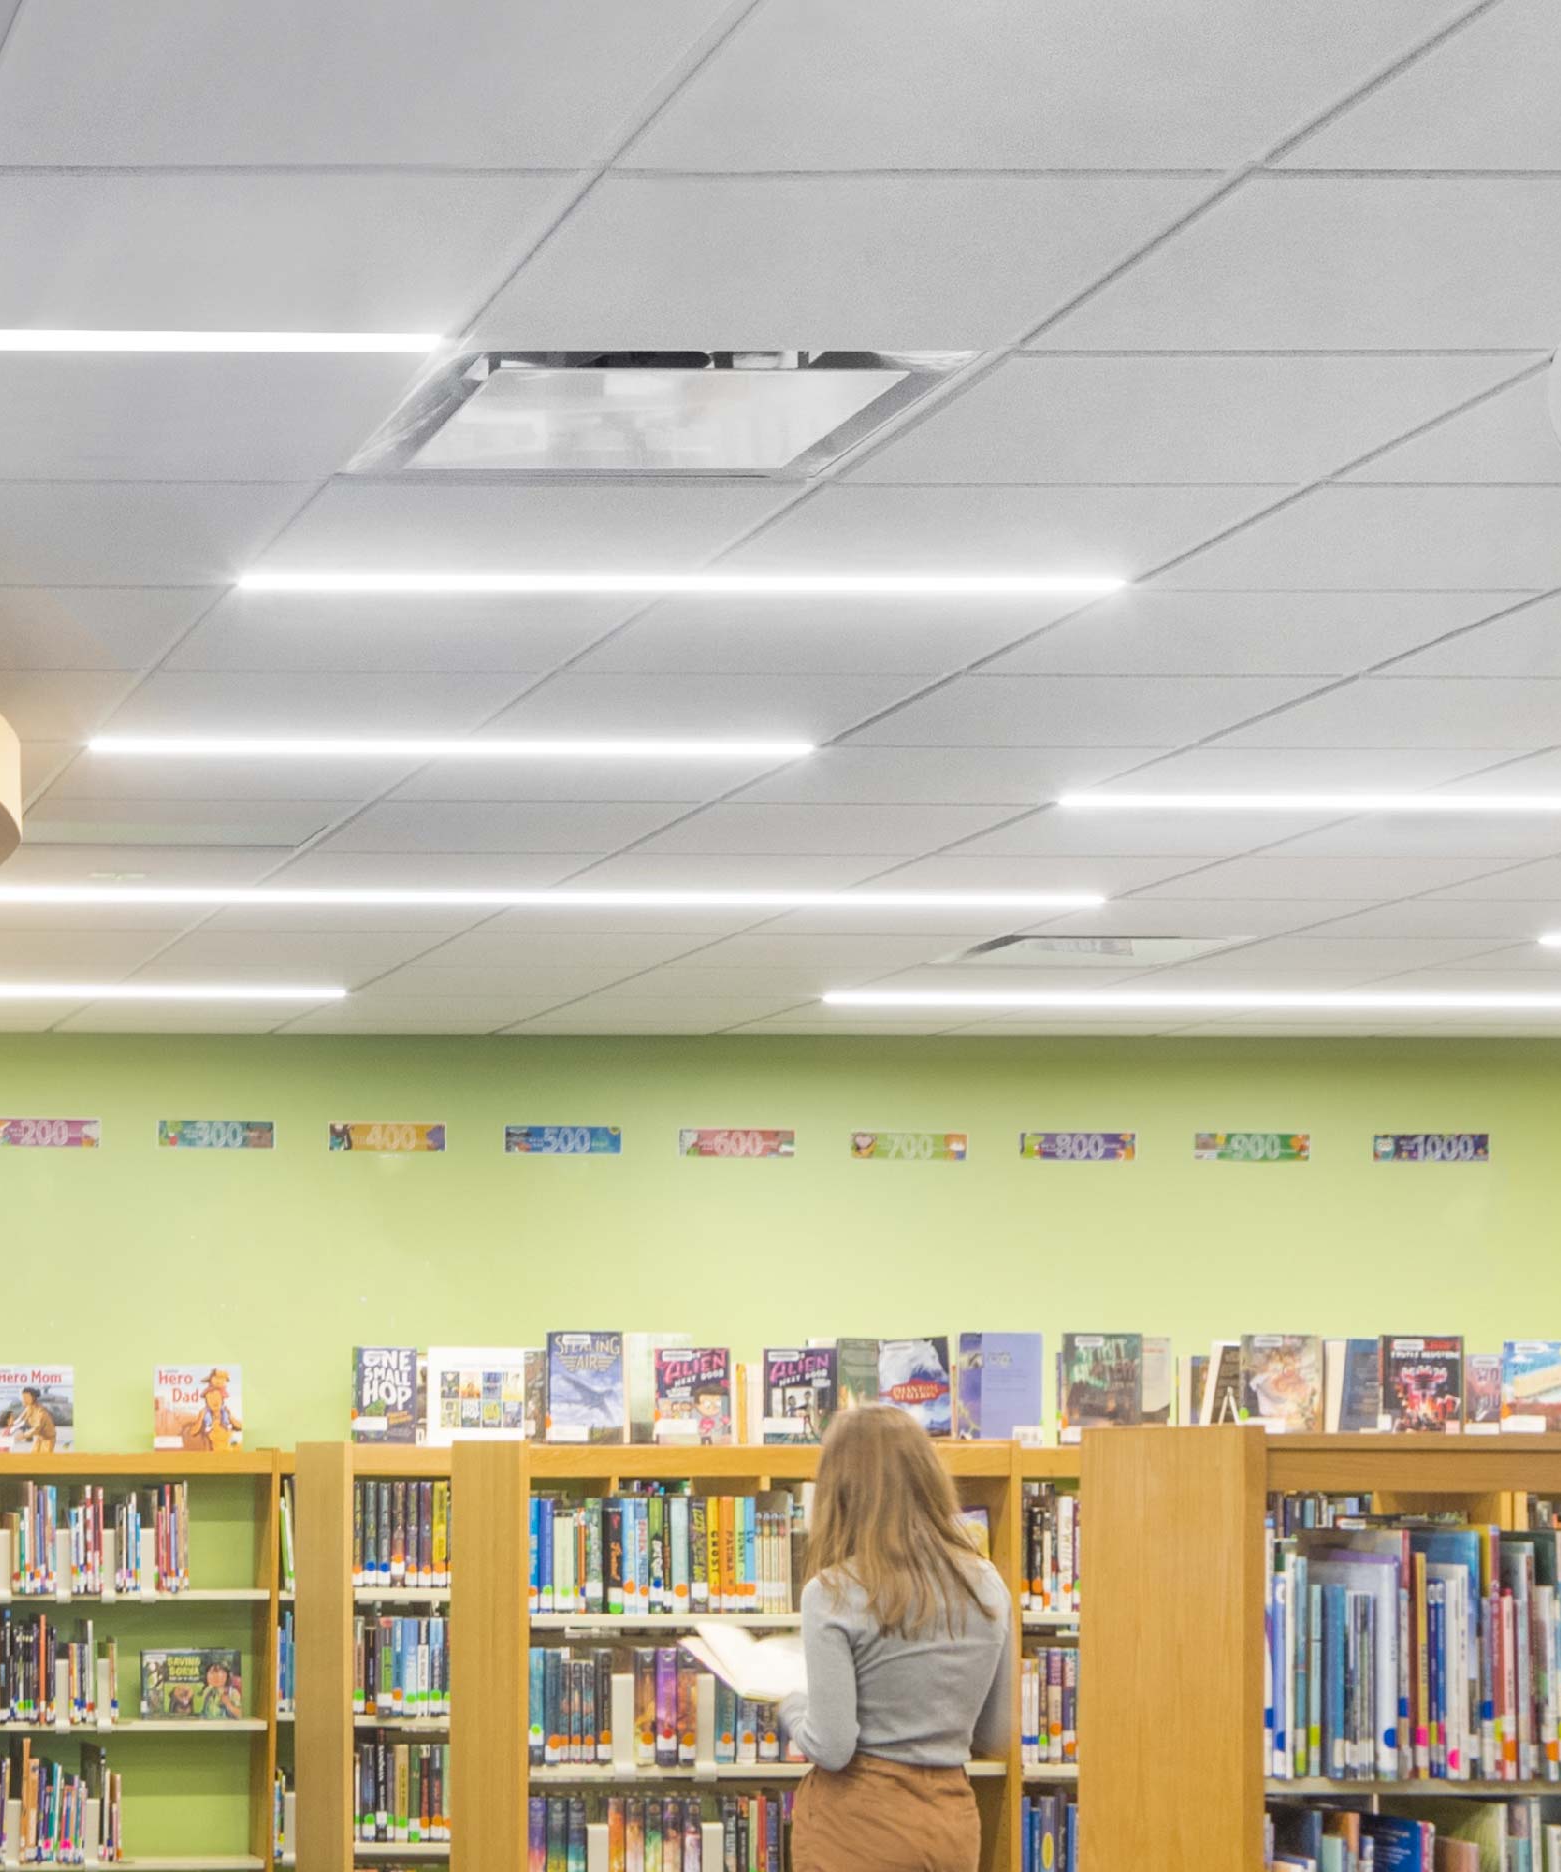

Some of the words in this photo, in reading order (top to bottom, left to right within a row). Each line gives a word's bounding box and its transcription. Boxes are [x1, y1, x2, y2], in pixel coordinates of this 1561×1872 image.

[20, 1120, 68, 1145] 200
[193, 1121, 242, 1148] 300
[366, 1125, 415, 1150] 400
[542, 1127, 590, 1152] 500
[714, 1130, 762, 1157] 600
[887, 1134, 934, 1159] 700
[1055, 1134, 1104, 1160] 800
[1230, 1134, 1280, 1160] 900
[1417, 1135, 1474, 1161] 1000
[363, 1350, 411, 1371] ONE
[575, 1355, 599, 1370] AIR
[663, 1353, 726, 1385] ALIEN
[769, 1353, 829, 1384] ALIEN
[31, 1370, 63, 1384] Mom
[159, 1370, 193, 1385] Hero
[364, 1367, 411, 1386] SMALL
[172, 1387, 199, 1403] Dad
[362, 1381, 412, 1411] HOP
